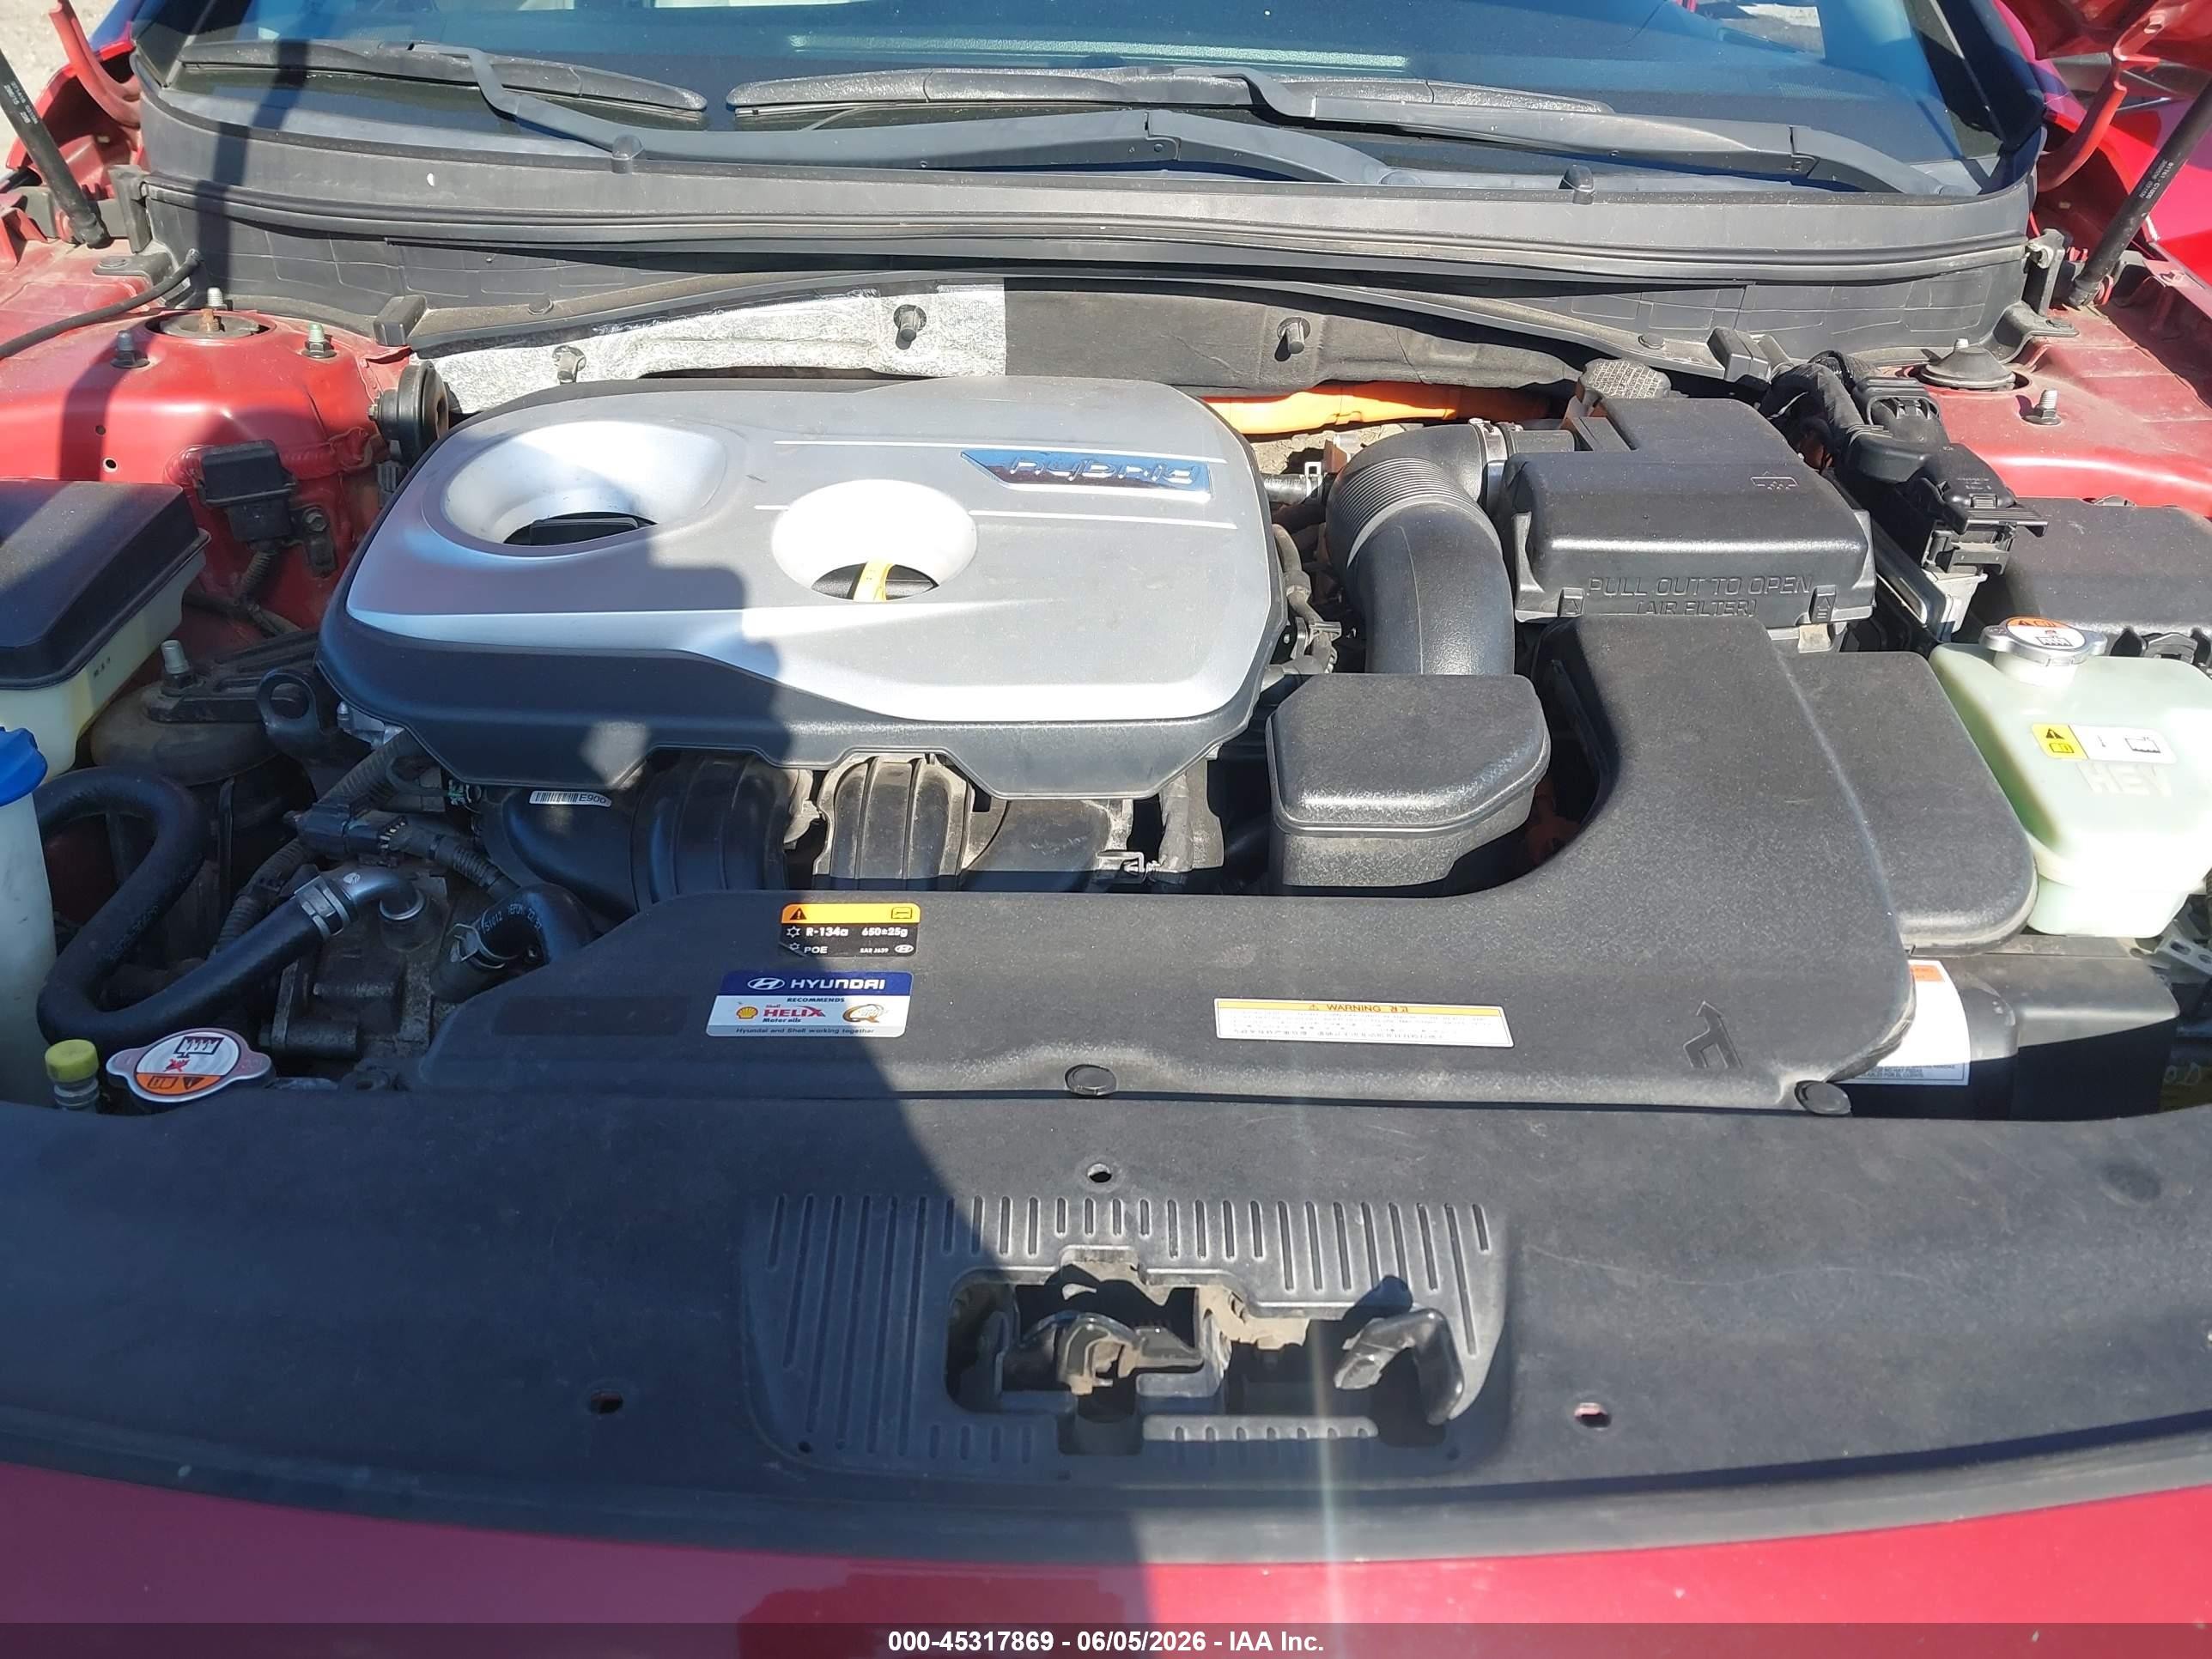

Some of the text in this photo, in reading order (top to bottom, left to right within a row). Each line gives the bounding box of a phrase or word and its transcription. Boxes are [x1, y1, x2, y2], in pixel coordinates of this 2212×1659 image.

[1587, 576, 1812, 596] PULL OUT TO OPEN
[805, 927, 908, 938] R-134a 650±25g
[804, 945, 829, 954] POE
[790, 979, 885, 990] HYUNDAI
[763, 1006, 825, 1018] HELIX
[1327, 1003, 1382, 1012] WARNING
